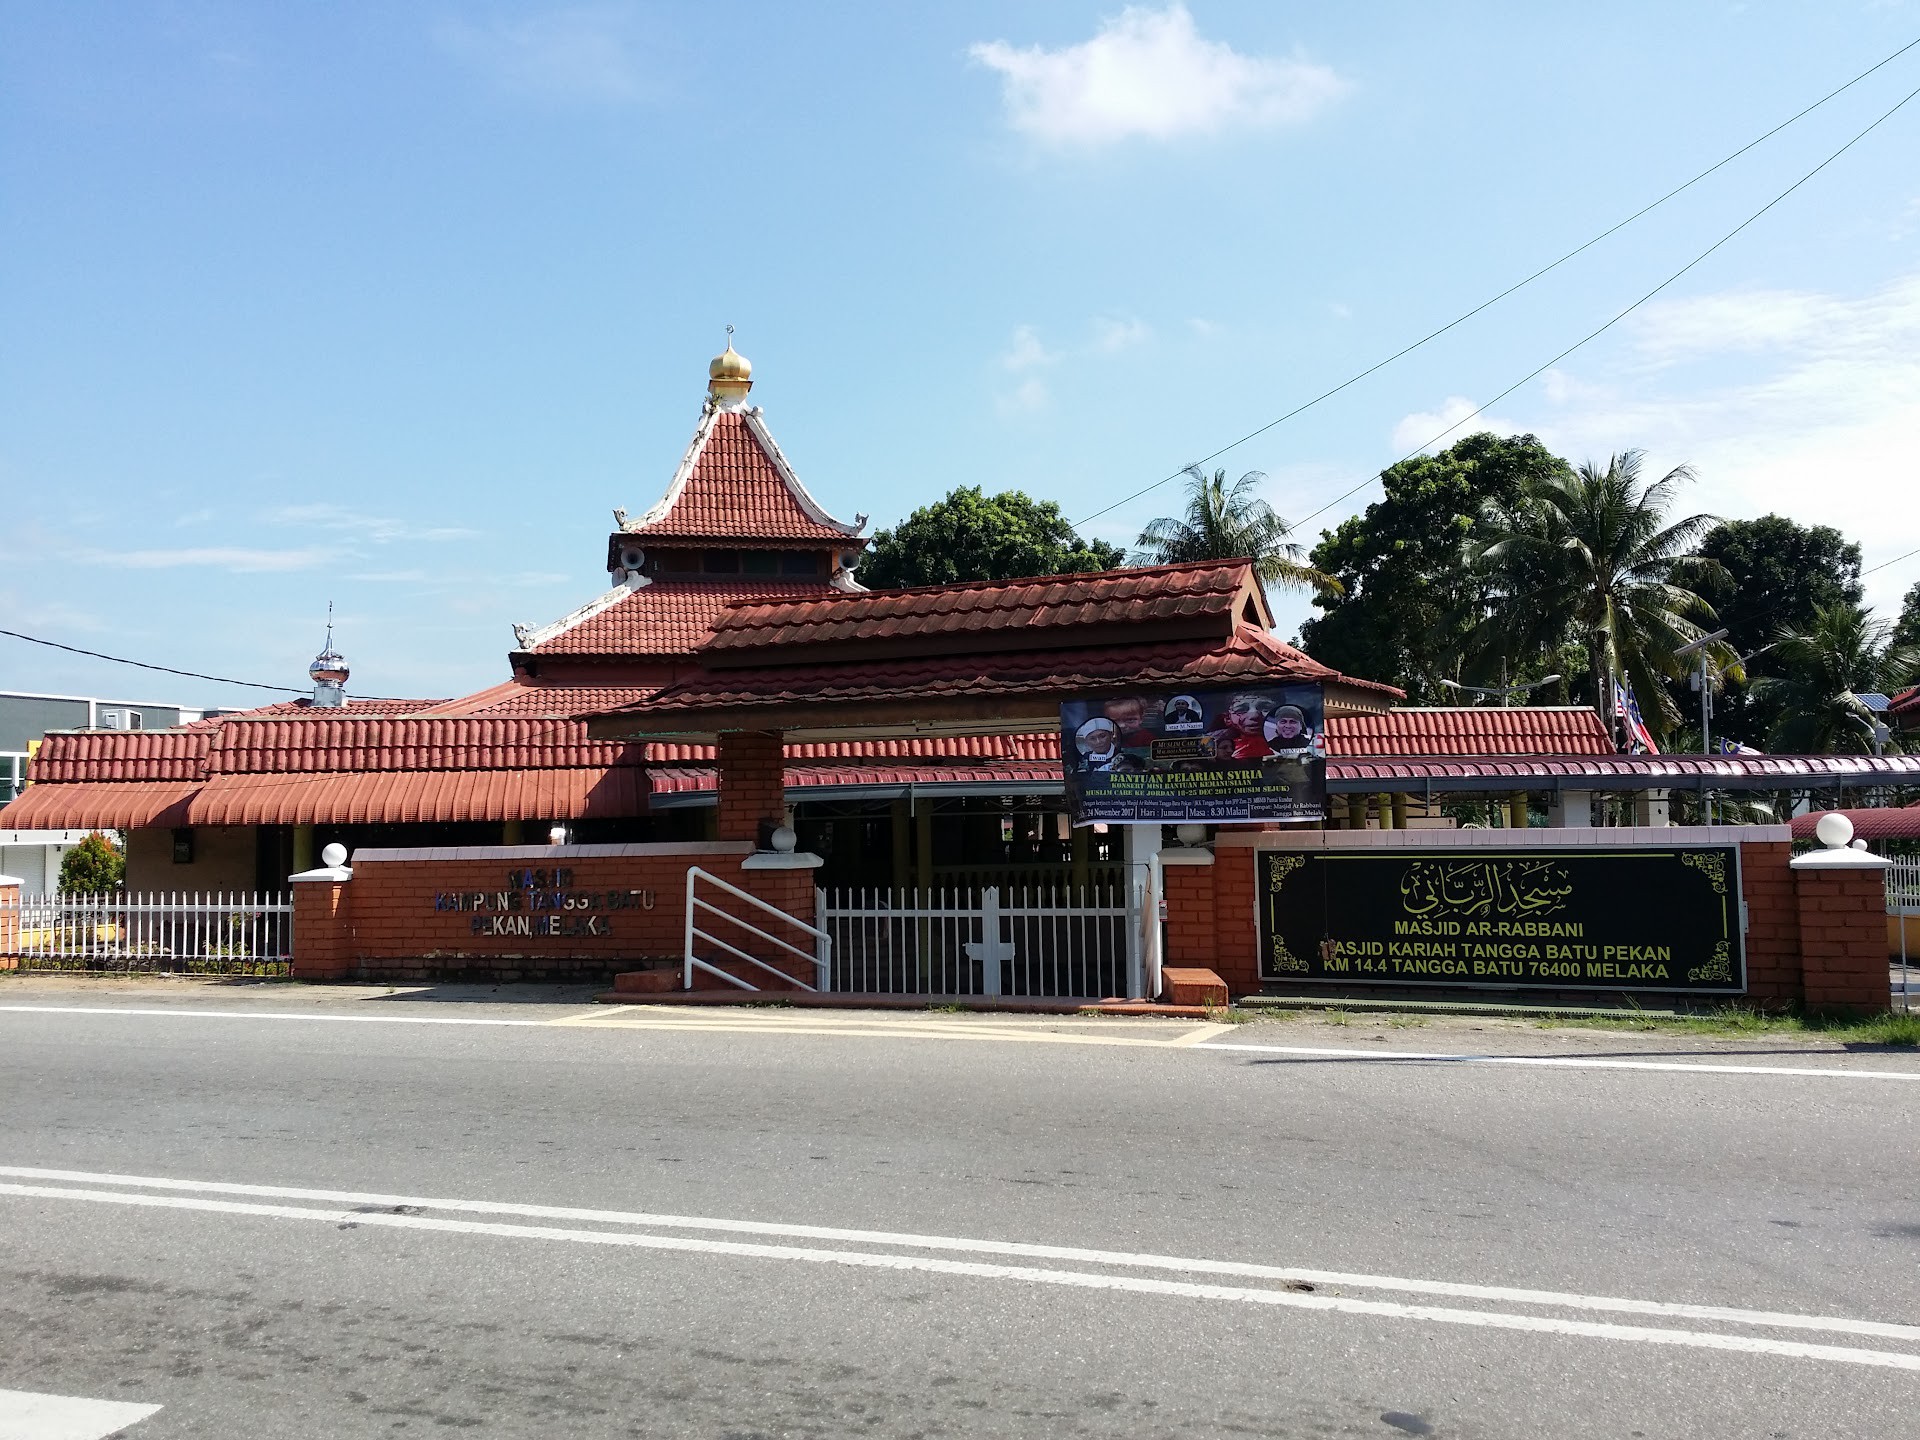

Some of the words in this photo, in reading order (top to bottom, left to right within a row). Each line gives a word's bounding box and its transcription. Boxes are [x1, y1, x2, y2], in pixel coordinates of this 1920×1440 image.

[1110, 773, 1163, 783] BANTUAN
[1166, 771, 1223, 782] PELARIAN
[1227, 769, 1263, 780] SYRIA
[1165, 781, 1198, 789] BANTUAN
[1200, 779, 1252, 788] KEMANUSIAAN
[1199, 788, 1213, 796] DEC
[1215, 787, 1231, 795] 2017
[1233, 786, 1260, 794] (MUSIM
[1263, 785, 1290, 793] SEJUK)
[1087, 808, 1093, 817] 24
[1094, 808, 1120, 817] November
[1121, 808, 1134, 817] 2017
[1189, 808, 1206, 817] Masa
[1210, 807, 1224, 817] 8.30
[1225, 806, 1248, 816] Malam
[1273, 803, 1291, 811] Masjid
[1140, 808, 1156, 817] Hari
[1161, 808, 1184, 818] Jumaat
[1272, 810, 1292, 818] Tangga
[435, 891, 521, 911] KAMPUNG
[528, 889, 603, 911] TANGGA
[607, 889, 655, 910] BATU
[1395, 921, 1461, 936] MASJID
[1466, 921, 1584, 937] AR-RABBANI
[1325, 941, 1383, 956] ASJID
[1388, 942, 1456, 957] KARIAH
[1461, 943, 1540, 959] TANGGA
[1546, 945, 1597, 960] BATU
[1603, 946, 1671, 961] PEKAN
[1324, 958, 1349, 972] KM
[1354, 959, 1387, 973] 14.4
[1392, 959, 1468, 975] TANGGA
[1474, 961, 1523, 976] BATU
[1529, 961, 1580, 977] 76400
[1587, 963, 1669, 978] MELAKA
